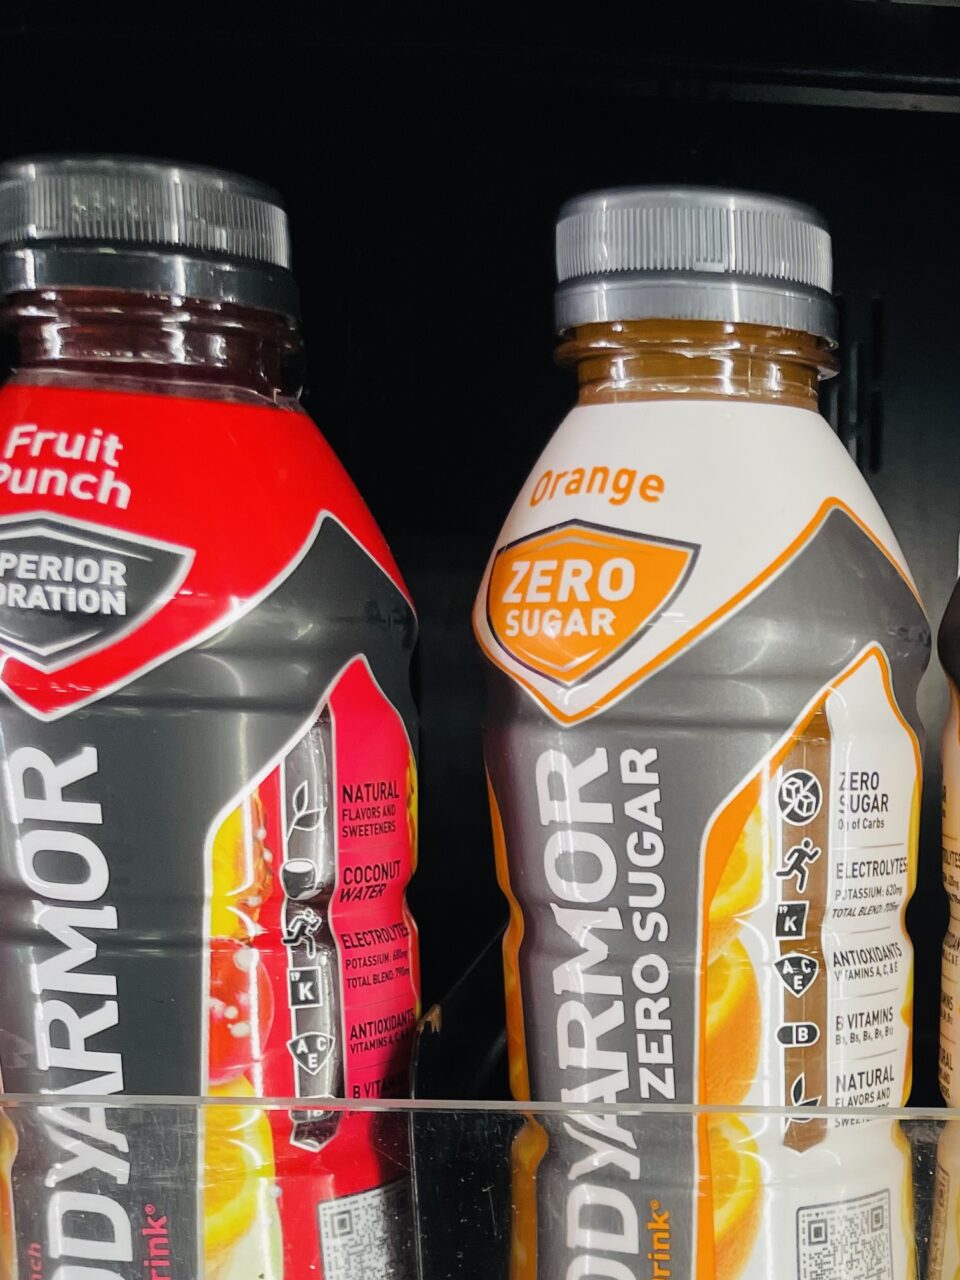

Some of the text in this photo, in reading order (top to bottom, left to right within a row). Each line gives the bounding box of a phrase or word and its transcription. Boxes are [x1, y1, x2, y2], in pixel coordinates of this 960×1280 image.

[4, 424, 124, 467] Fruit
[0, 460, 131, 510] Punch
[530, 465, 665, 507] Orange
[0, 553, 127, 586] PERIOR
[501, 557, 636, 604] ZERO
[0, 584, 127, 616] RATION
[504, 606, 616, 637] SUGAR
[342, 781, 400, 803] NATURAL
[839, 771, 880, 792] ZERO
[342, 804, 397, 823] FLAVORS AND
[838, 793, 889, 814] SUGAR
[342, 821, 397, 839] SWEETENERS
[852, 816, 885, 830] of Carbs
[343, 859, 401, 885] COCONUT
[340, 884, 387, 902] WATER
[619, 747, 676, 1100] ZERO SUGAR
[832, 907, 857, 919] TOTAL
[833, 942, 902, 967] ANTIOXIDANTS
[347, 976, 371, 989] TOTAL
[847, 1006, 894, 1030] VITAMINS
[350, 1036, 388, 1054] VITAMINS
[836, 1064, 894, 1093] NATURAL
[877, 1087, 891, 1101] AND
